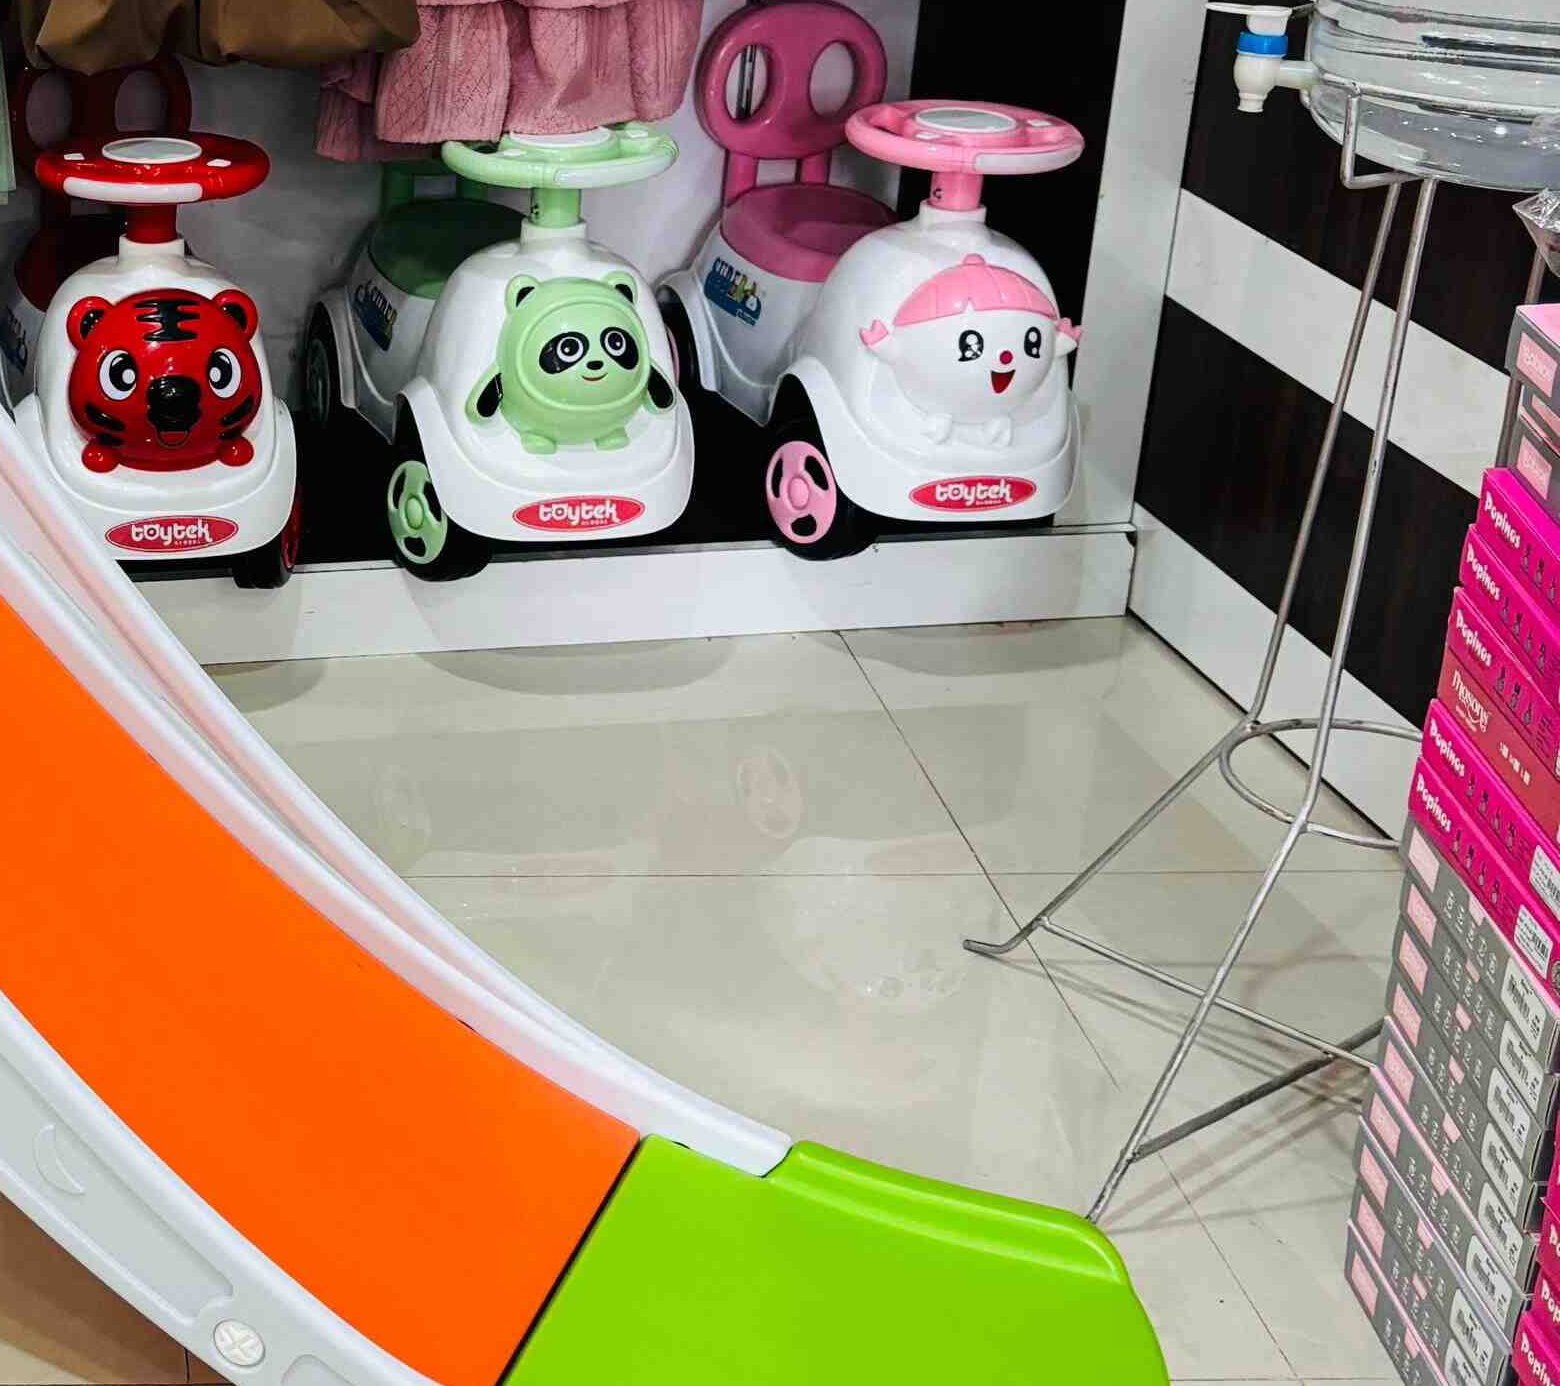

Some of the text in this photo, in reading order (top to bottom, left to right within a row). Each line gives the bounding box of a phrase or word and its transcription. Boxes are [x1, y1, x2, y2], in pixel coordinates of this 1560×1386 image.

[935, 478, 1014, 506] toytek
[538, 500, 621, 526] toytek
[131, 519, 213, 546] toytek
